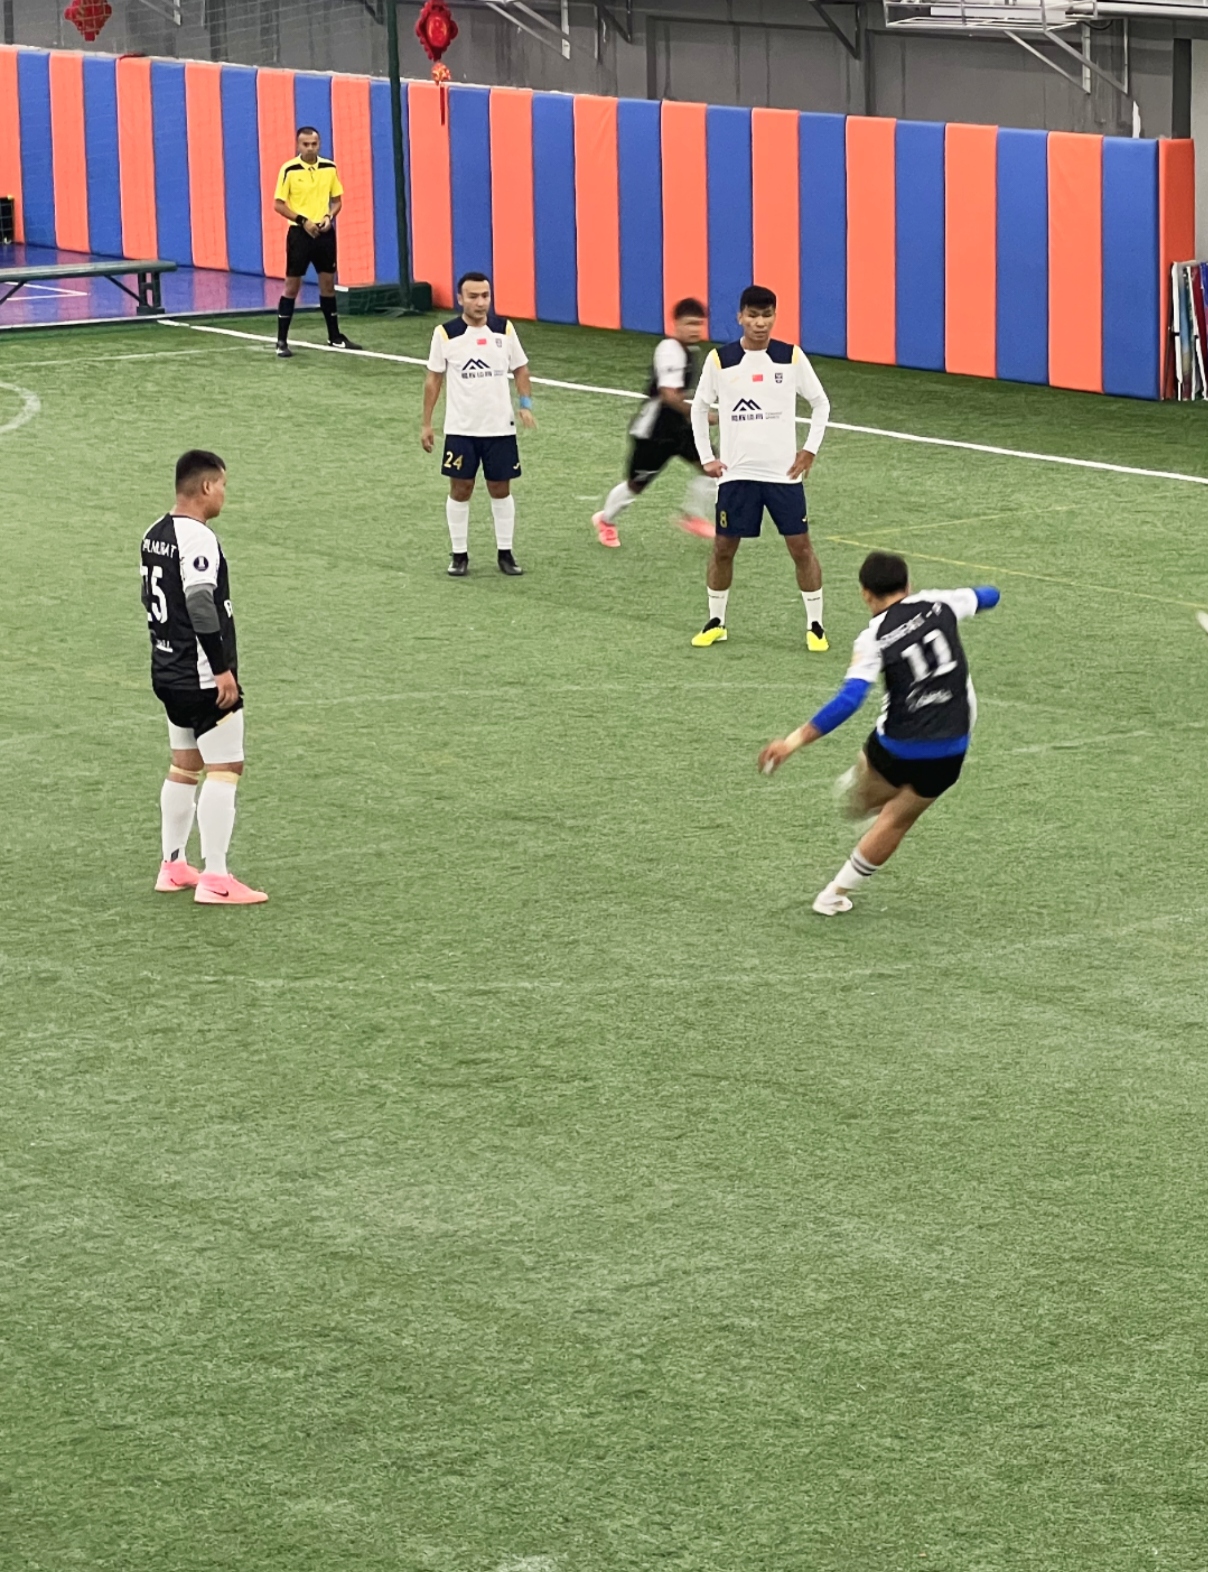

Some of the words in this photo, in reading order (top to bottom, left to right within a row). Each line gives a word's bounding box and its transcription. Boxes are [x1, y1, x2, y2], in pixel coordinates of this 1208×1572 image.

[443, 450, 464, 471] 24
[719, 510, 728, 529] 8
[901, 628, 958, 687] 11
